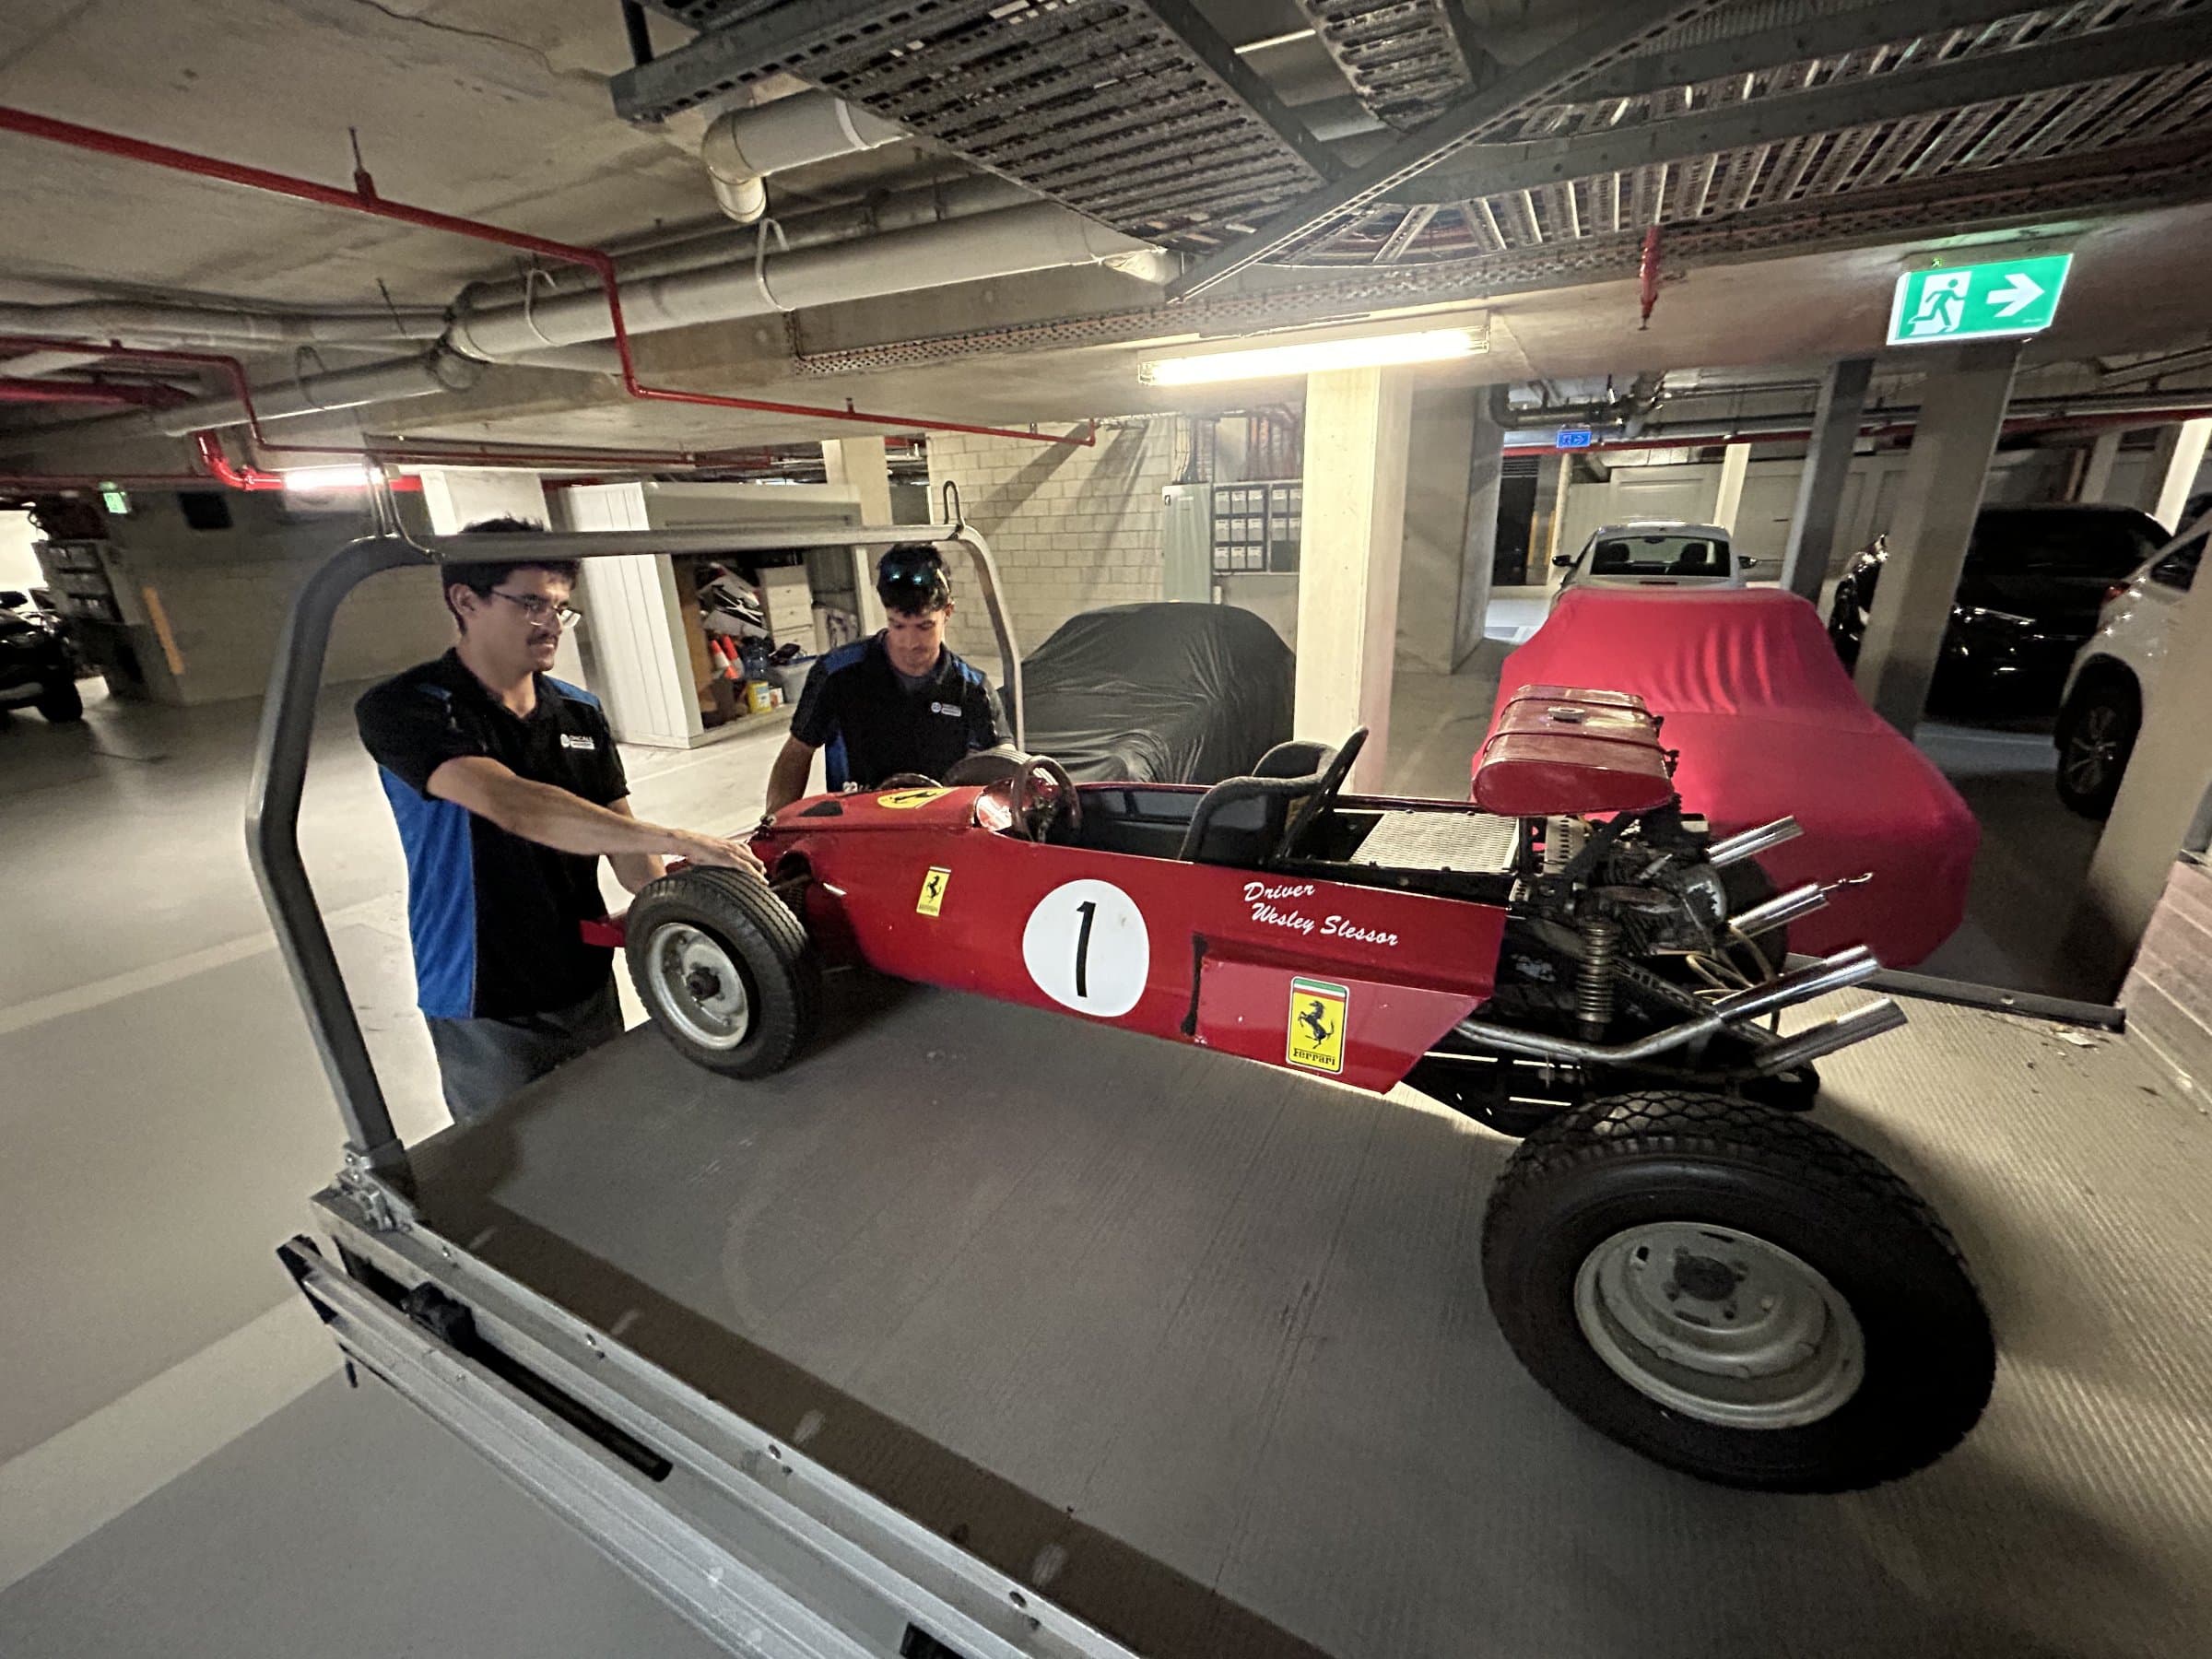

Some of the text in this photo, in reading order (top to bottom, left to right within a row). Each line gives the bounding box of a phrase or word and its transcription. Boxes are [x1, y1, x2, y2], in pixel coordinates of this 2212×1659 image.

[1244, 882, 1315, 901] Driver
[1252, 902, 1398, 946] Wesley Slessor
[1077, 901, 1096, 997] 1
[1293, 1048, 1335, 1065] Ferrari
